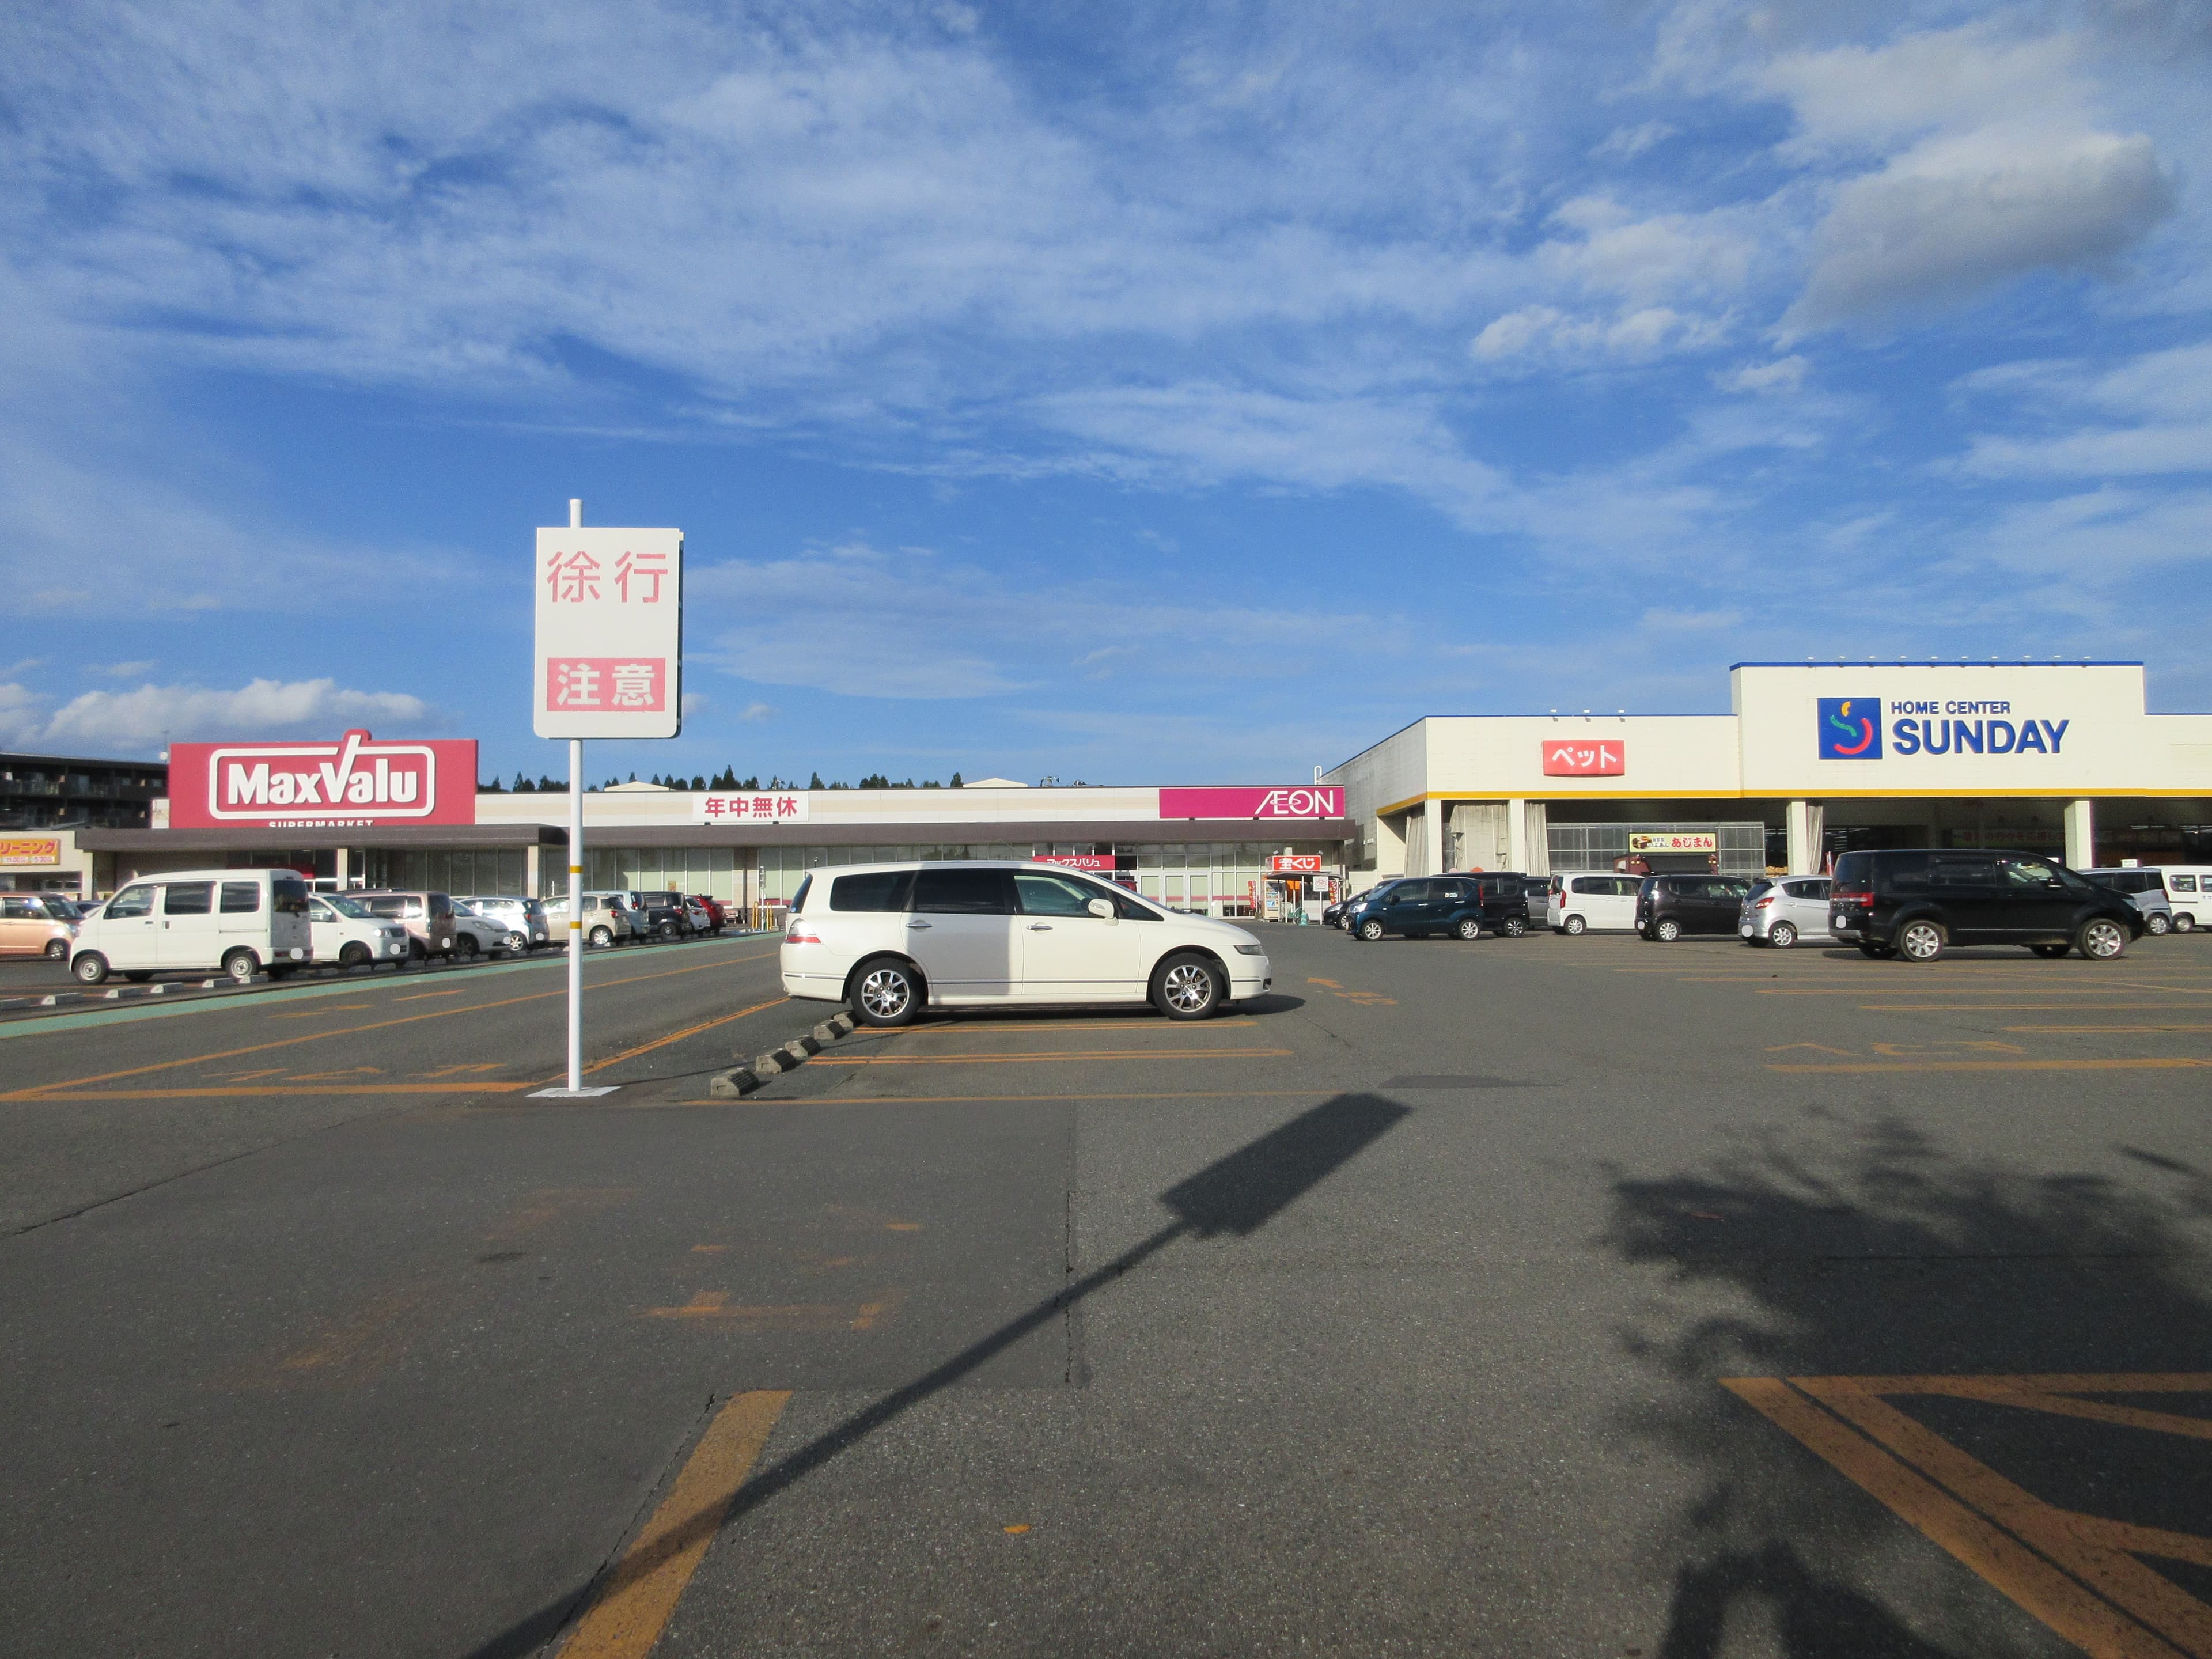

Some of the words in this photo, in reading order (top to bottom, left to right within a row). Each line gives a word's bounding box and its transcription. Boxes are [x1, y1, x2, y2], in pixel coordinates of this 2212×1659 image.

[547, 551, 668, 603] 徐行
[556, 663, 655, 706] 注意
[1891, 700, 1940, 714] HOME
[1945, 700, 2010, 714] CENTER
[1892, 718, 2070, 755] SUNDAY
[1552, 745, 1617, 768] ペット
[228, 735, 418, 805] MaxValu
[704, 797, 797, 818] 年中無休
[1671, 837, 1713, 849] あじまん
[1278, 857, 1316, 870] 宝くじ
